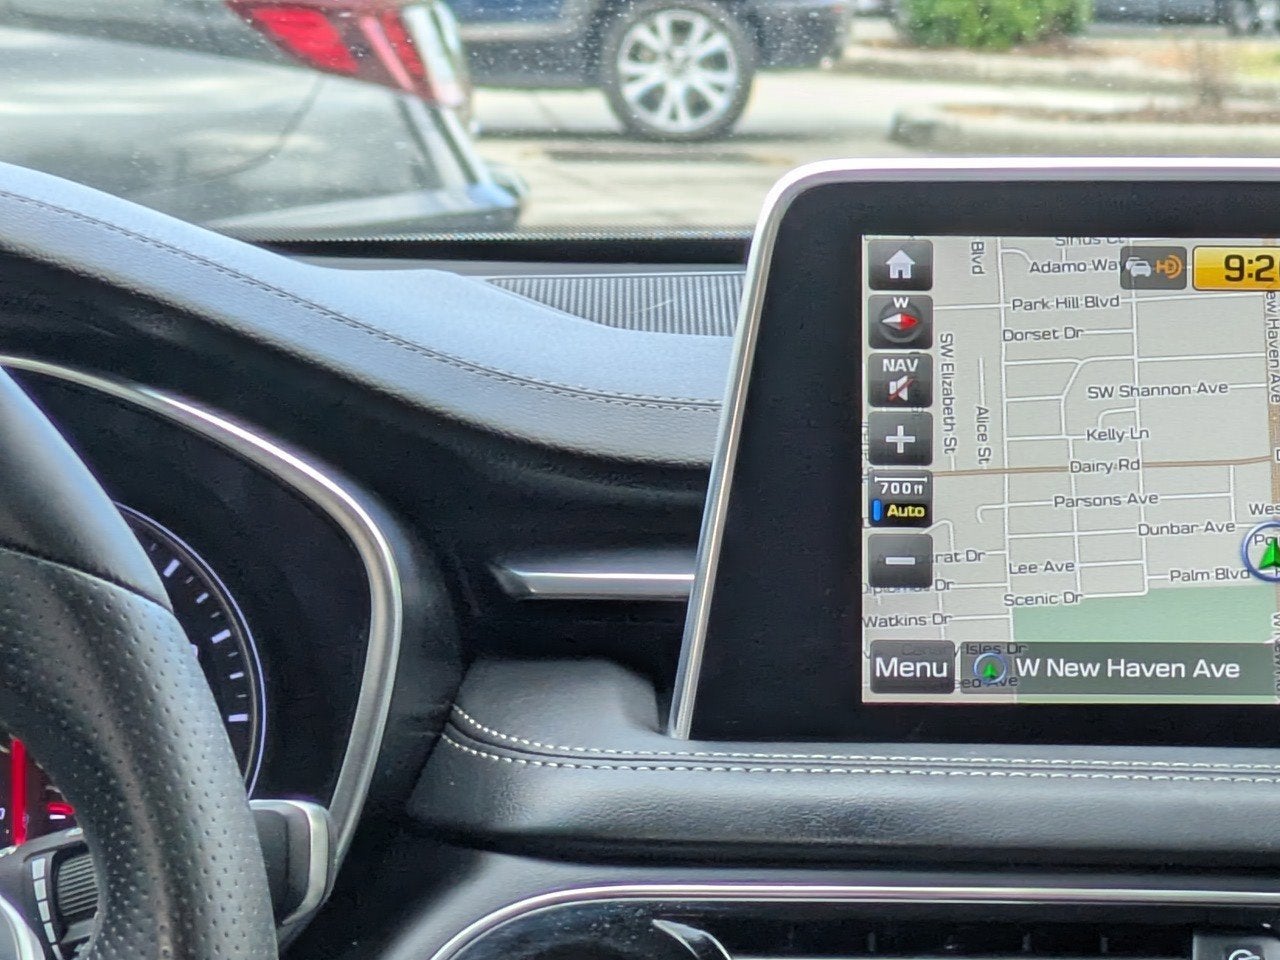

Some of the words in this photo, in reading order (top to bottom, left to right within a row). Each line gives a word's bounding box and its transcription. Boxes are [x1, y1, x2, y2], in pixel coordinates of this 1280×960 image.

[971, 241, 985, 275] Blvd
[1030, 260, 1086, 274] Adamo
[893, 297, 909, 308] W
[1012, 298, 1050, 311] Park
[1056, 297, 1079, 309] Hill
[1085, 295, 1120, 308] Blvd
[1003, 328, 1059, 342] Dorset
[1064, 326, 1084, 339] Dr
[940, 332, 954, 358] SW
[1267, 318, 1280, 369] Haven
[883, 358, 919, 372] NAV
[941, 363, 956, 432] Elizabeth
[1088, 385, 1114, 399] SW
[1119, 384, 1191, 398] Shannon
[1197, 381, 1229, 395] Ave
[976, 406, 989, 442] Alice
[1087, 428, 1125, 443] Kelly
[1130, 428, 1150, 440] Ln
[944, 437, 958, 455] St
[978, 447, 991, 464] St
[1070, 460, 1115, 475] Dairy
[1119, 458, 1141, 471] Rd
[1054, 495, 1122, 508] Parsons
[1126, 492, 1159, 505] Ave
[887, 504, 926, 518] Auto
[1138, 522, 1199, 537] Dunbar
[1203, 520, 1236, 534] Ave
[966, 550, 986, 562] Dr
[1009, 562, 1038, 575] Lee
[1043, 560, 1075, 574] Ave
[1170, 568, 1209, 581] Palm
[1213, 567, 1251, 581] Blvd
[935, 579, 954, 591] Dr
[1004, 592, 1058, 607] Scenic
[1063, 591, 1083, 605] Dr
[863, 615, 927, 628] Watkins
[933, 612, 951, 625] Dr
[875, 657, 948, 678] Menu
[1016, 658, 1040, 677] W
[1047, 658, 1100, 678] New
[1107, 658, 1185, 678] Haven
[1194, 658, 1240, 678] Ave
